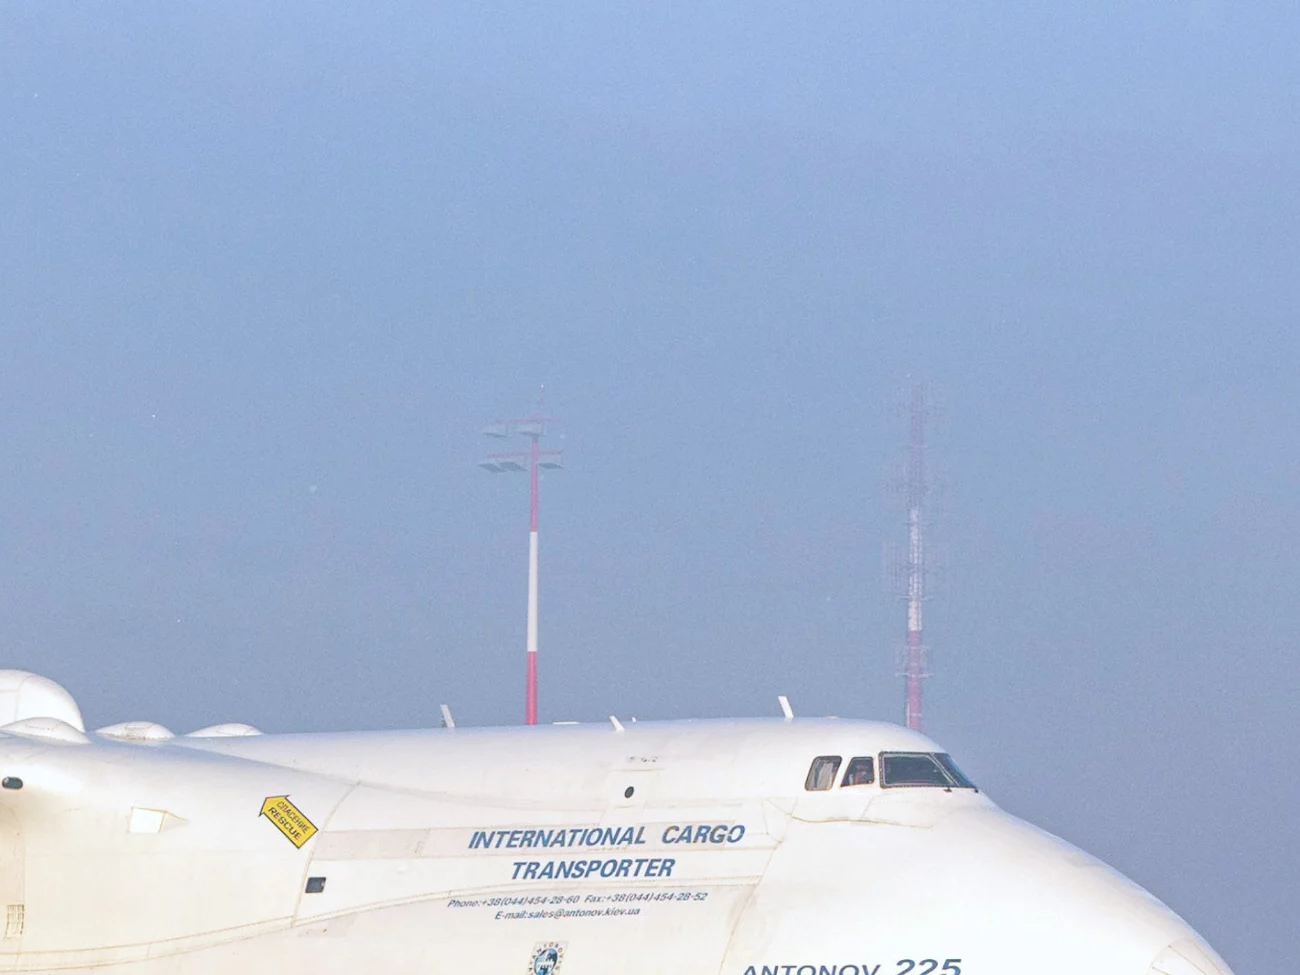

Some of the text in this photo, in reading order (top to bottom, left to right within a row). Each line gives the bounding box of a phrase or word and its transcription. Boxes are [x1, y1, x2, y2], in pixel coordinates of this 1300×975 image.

[267, 806, 302, 840] RESCUE
[468, 824, 746, 849] INTERNATIONAL CARGO
[511, 858, 676, 880] TRANSPORTER
